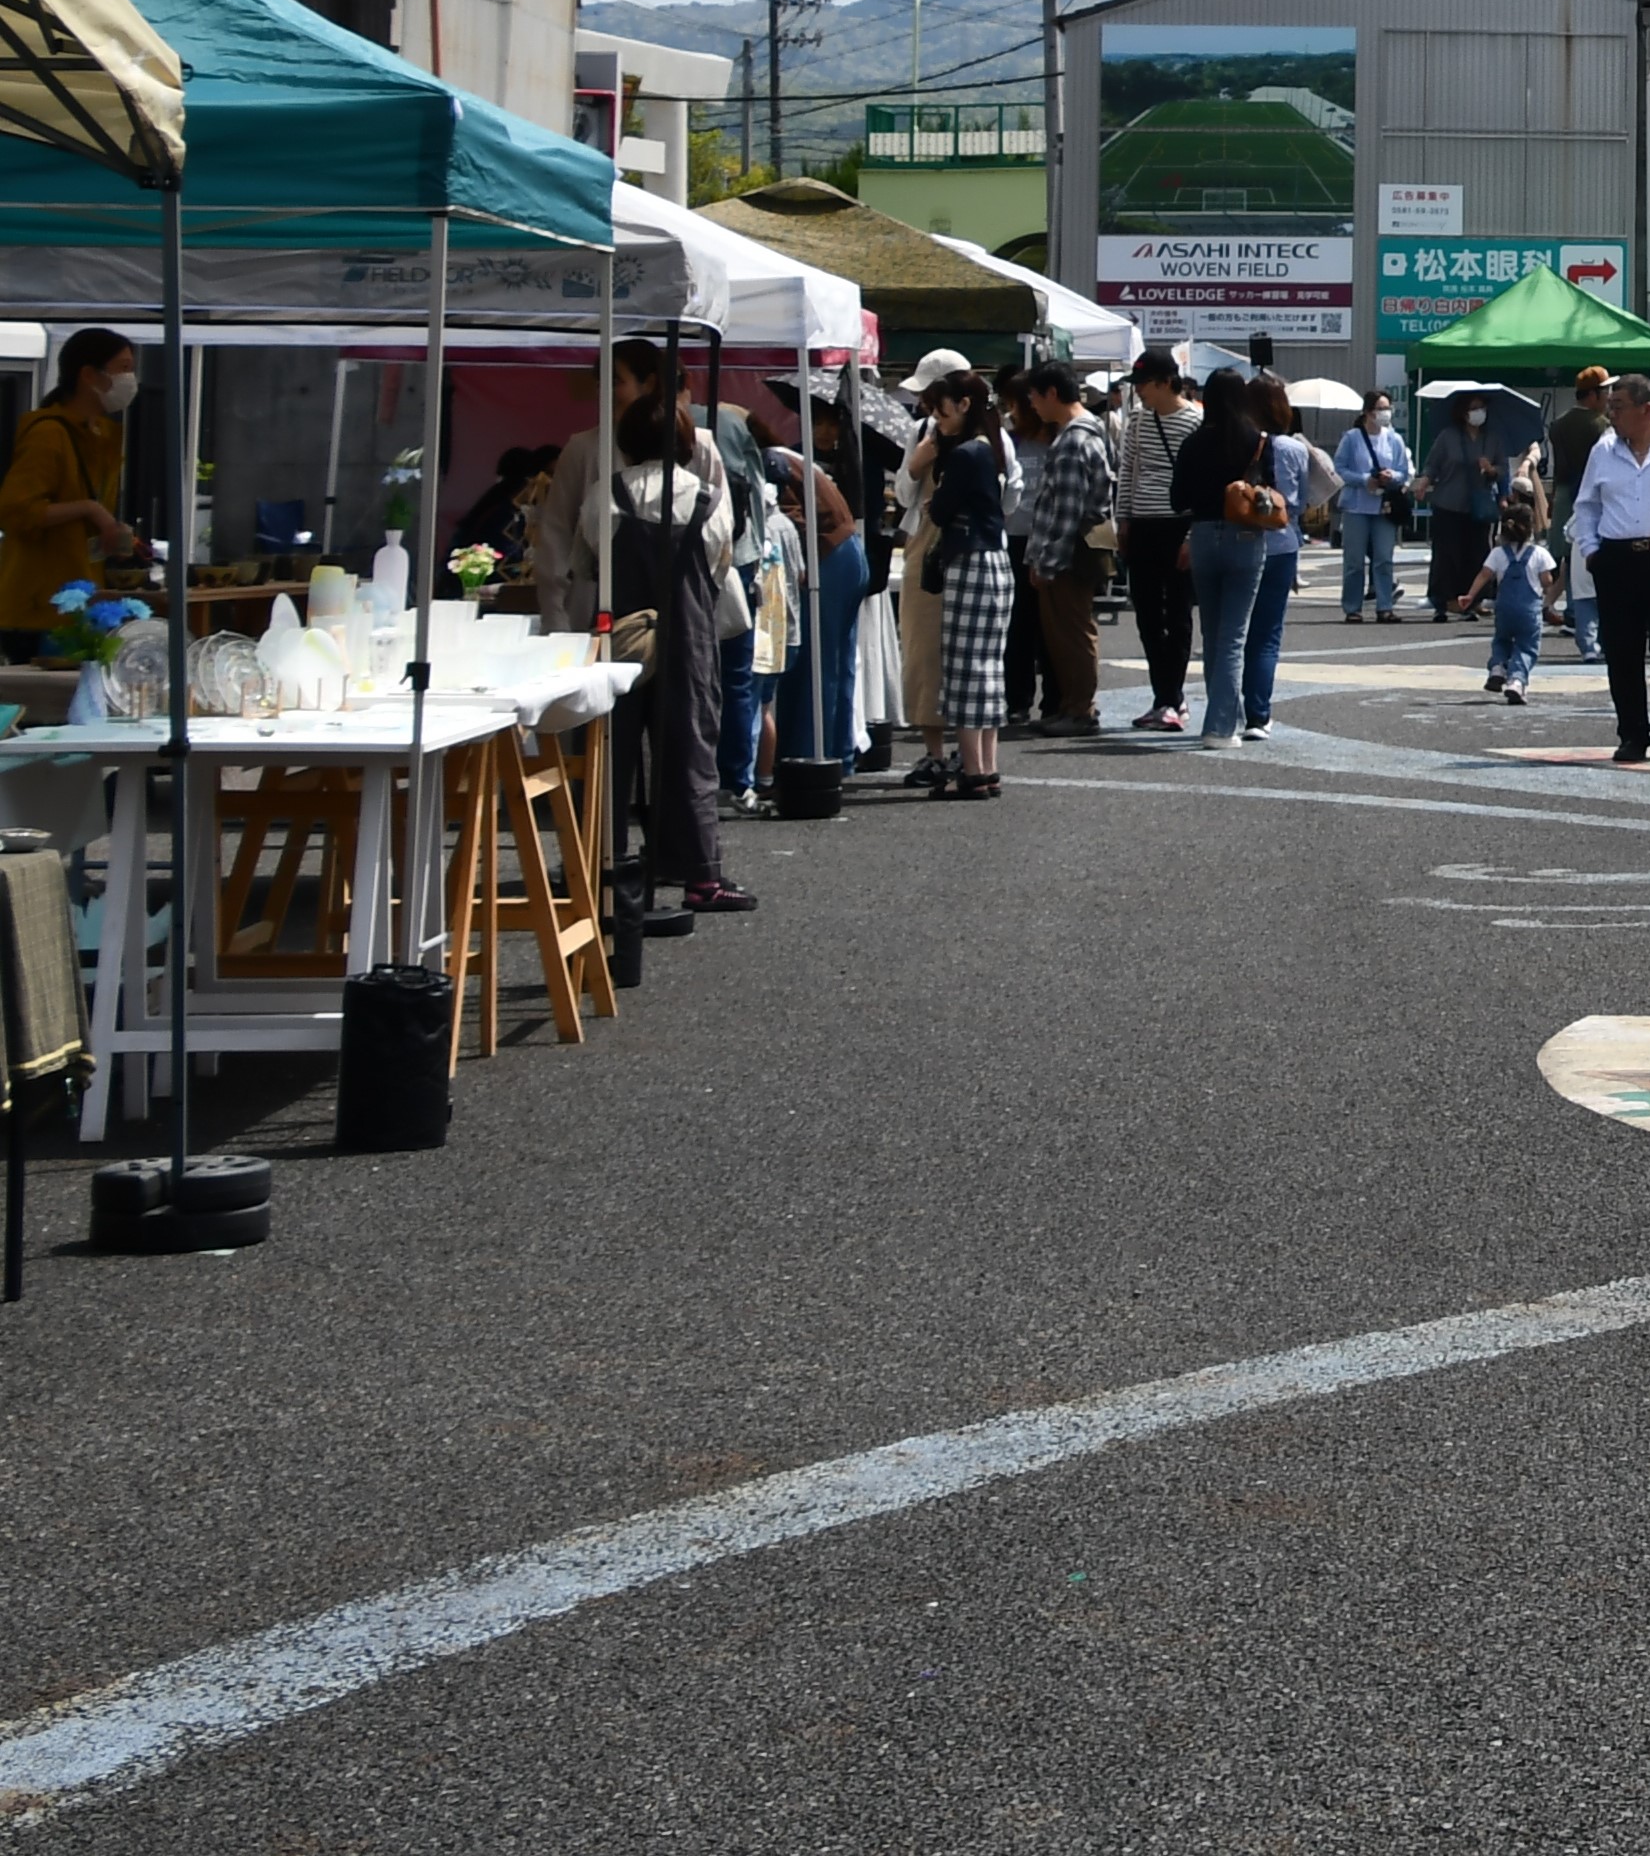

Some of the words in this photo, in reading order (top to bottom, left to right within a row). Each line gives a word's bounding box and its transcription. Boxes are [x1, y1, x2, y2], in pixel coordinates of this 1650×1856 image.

[1392, 190, 1450, 201] 広告募集中
[1156, 243, 1230, 258] ASAHI
[1237, 243, 1320, 259] INTECC
[1160, 262, 1232, 277] WOVEN
[1237, 262, 1290, 277] FIELD
[1414, 248, 1552, 282] 松本眼科
[1138, 288, 1226, 301] LOVELEDGE
[1200, 312, 1317, 322] 一般の方もご利用いただけます
